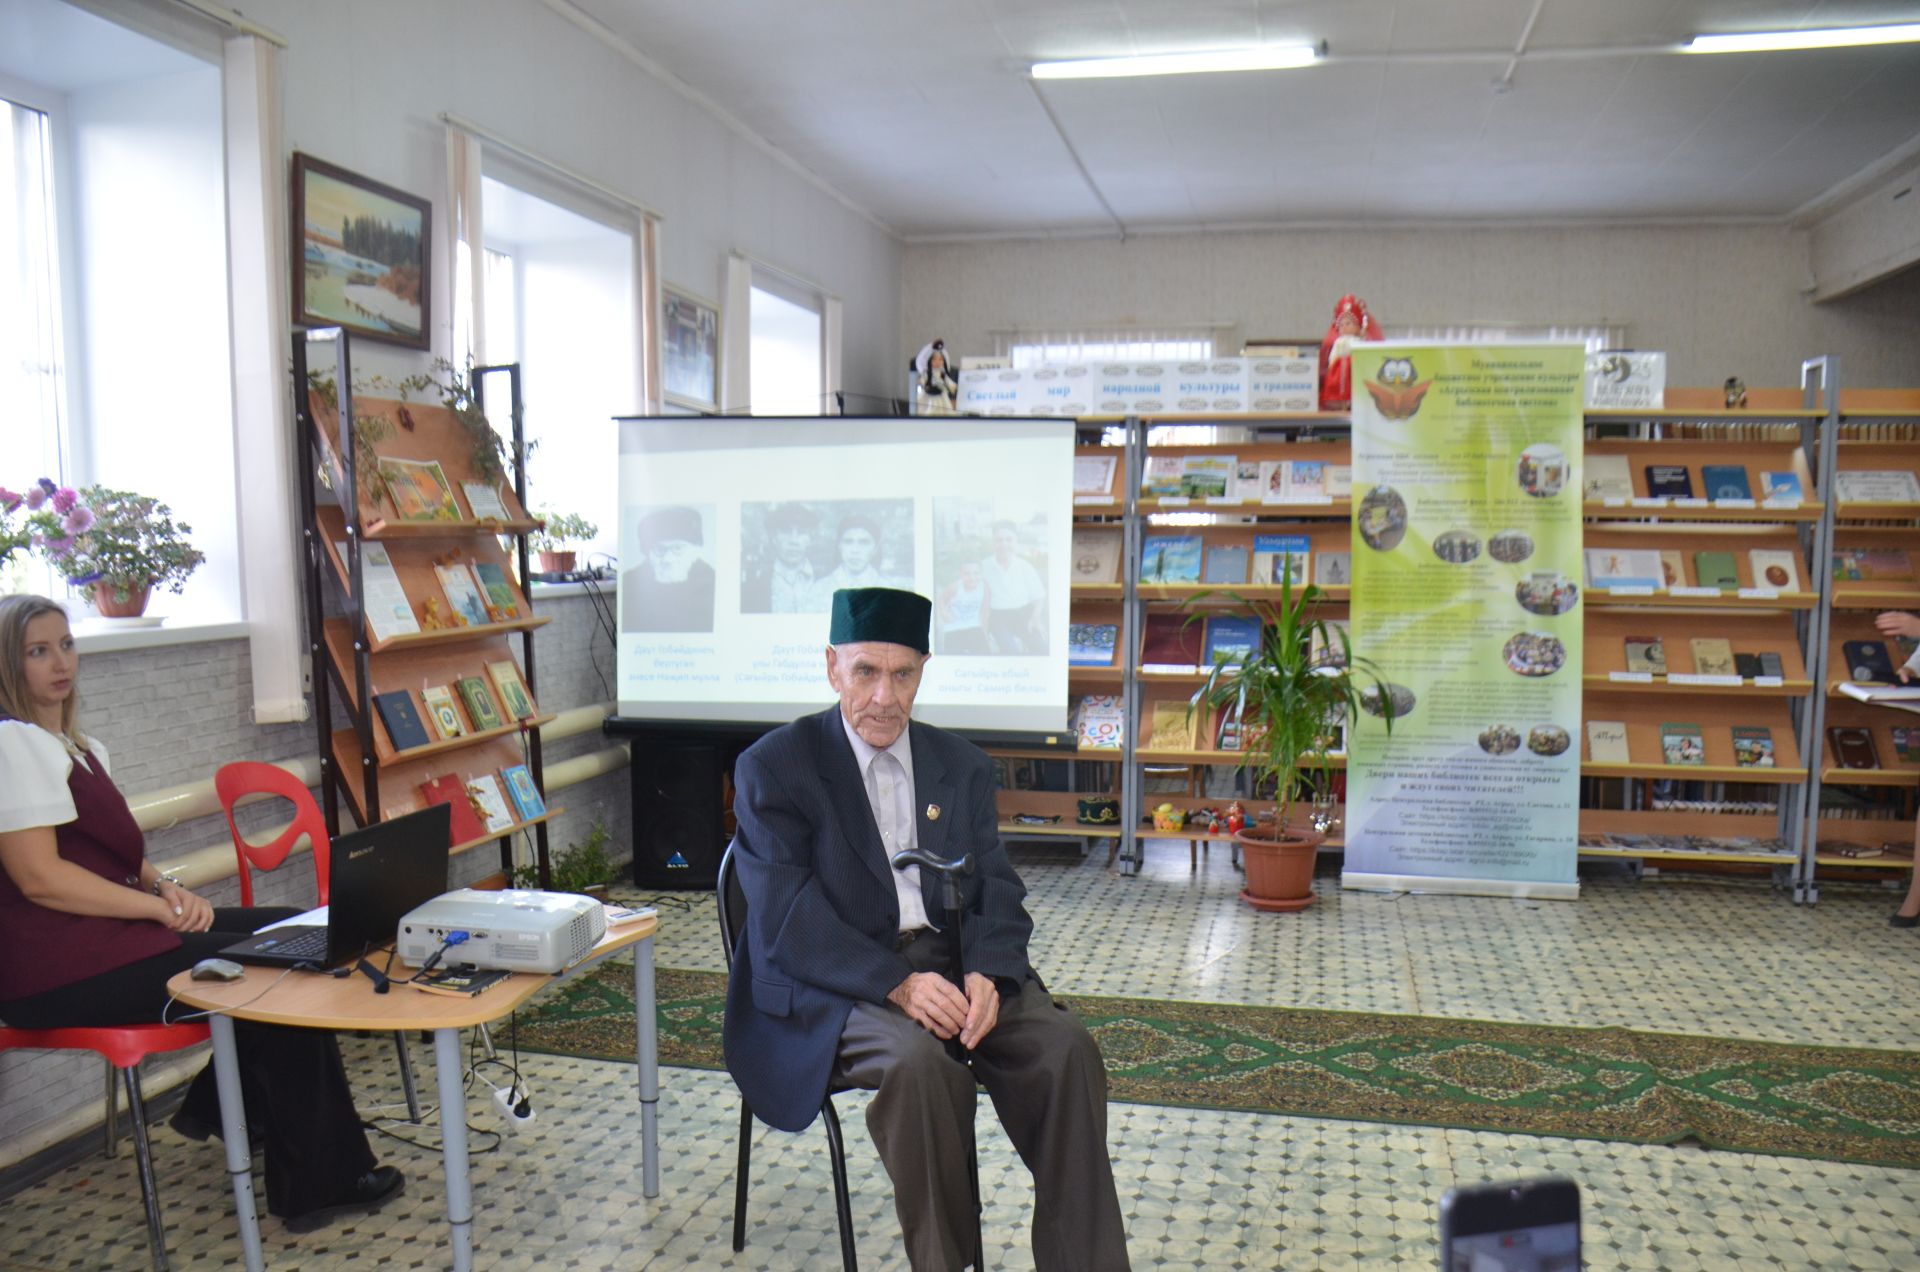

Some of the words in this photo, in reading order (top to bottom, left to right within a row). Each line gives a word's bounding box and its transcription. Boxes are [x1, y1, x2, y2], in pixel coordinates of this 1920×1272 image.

[967, 388, 1016, 401] Светлый
[1047, 384, 1071, 397] мир
[1103, 382, 1161, 395] народной
[1179, 382, 1240, 396] культуры
